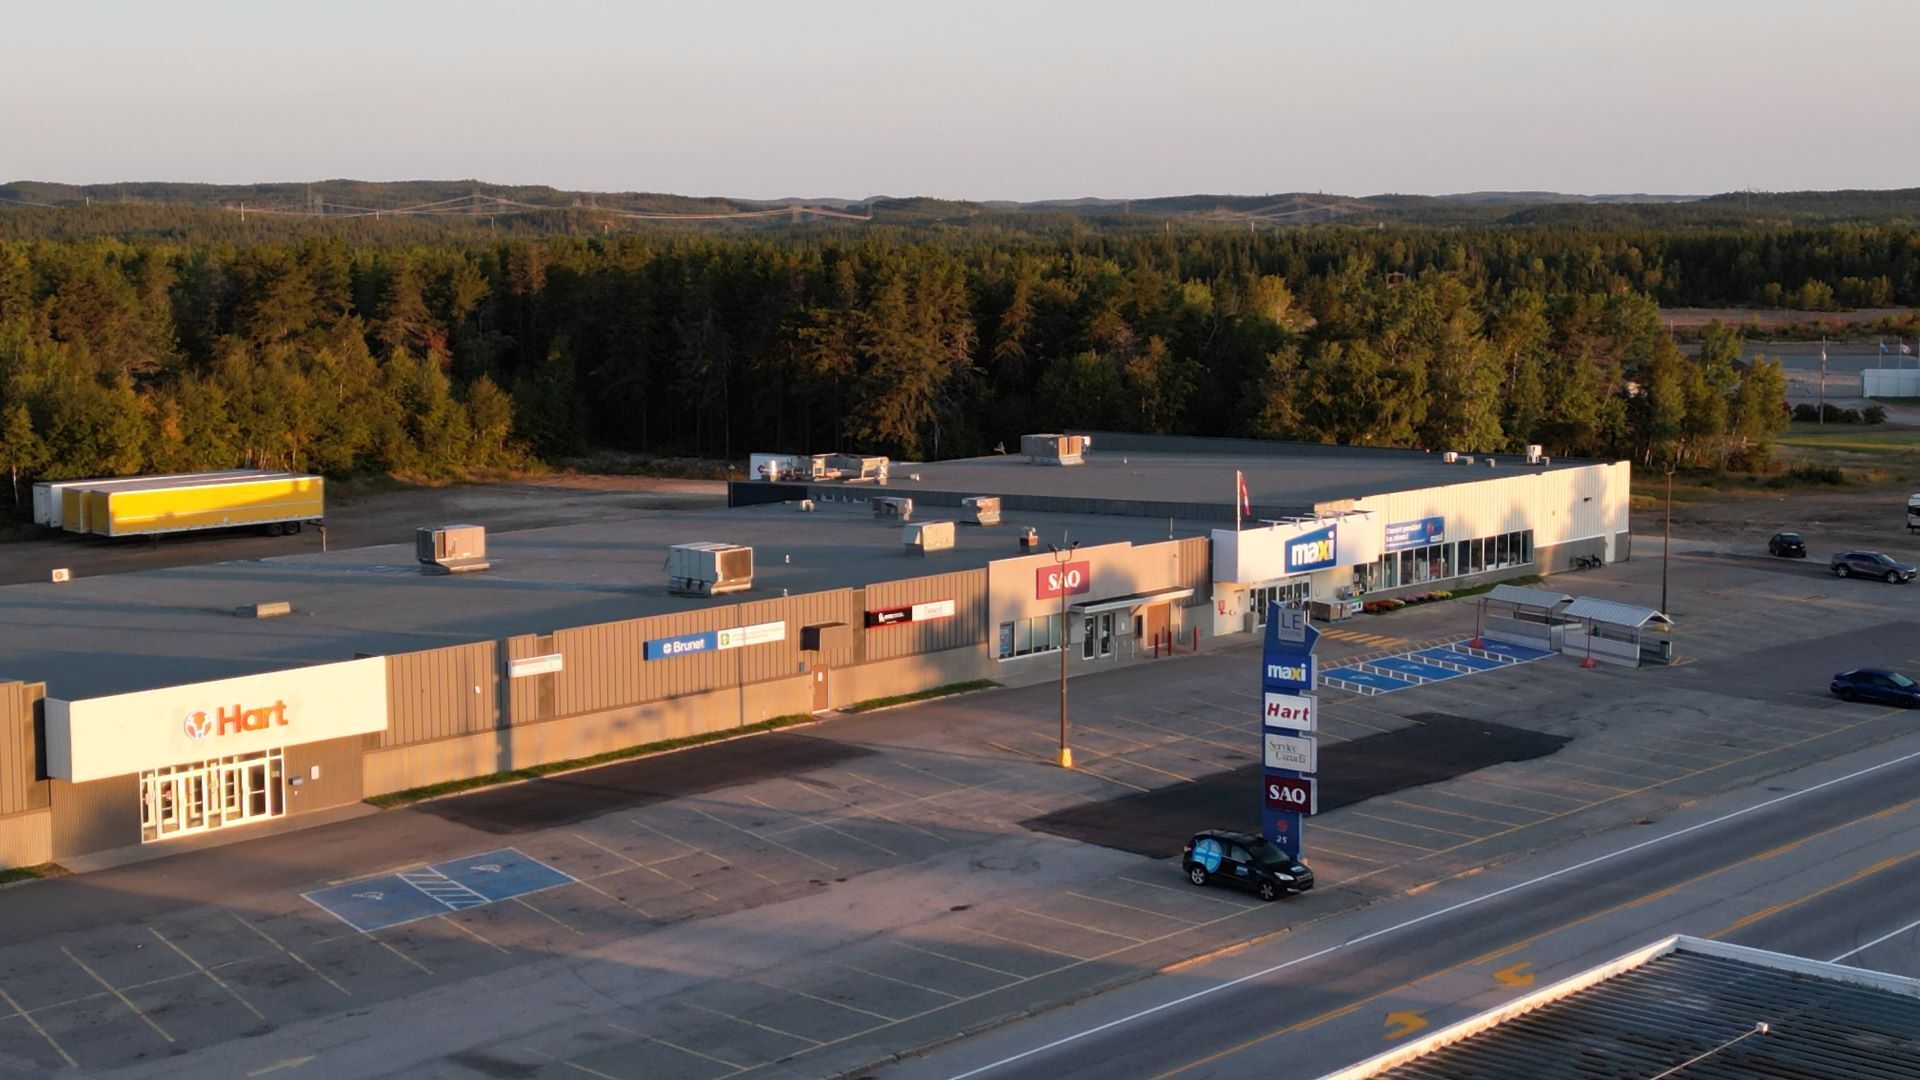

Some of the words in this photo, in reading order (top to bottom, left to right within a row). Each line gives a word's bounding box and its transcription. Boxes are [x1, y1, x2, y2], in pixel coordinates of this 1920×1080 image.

[1291, 530, 1335, 567] maxi
[1048, 569, 1081, 592] SAQ
[1281, 612, 1302, 630] LE
[673, 638, 705, 653] Brunet
[1267, 663, 1306, 682] maxi
[216, 699, 288, 736] Hart
[1267, 702, 1310, 722] Hart
[1269, 784, 1306, 805] SAQ
